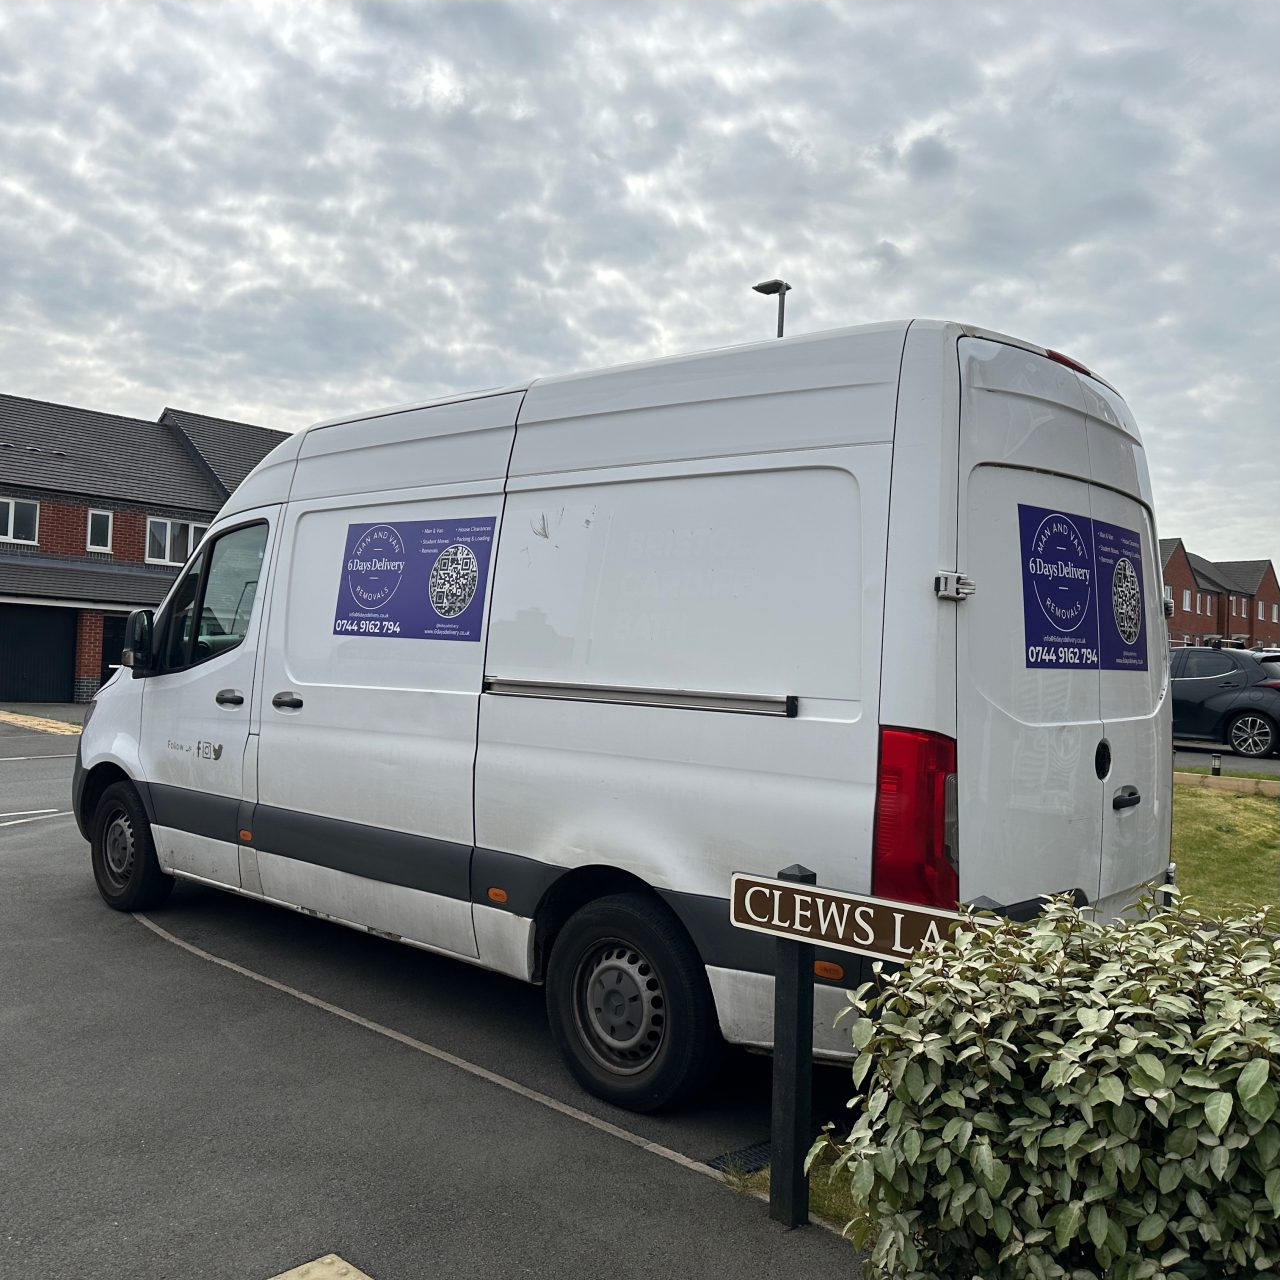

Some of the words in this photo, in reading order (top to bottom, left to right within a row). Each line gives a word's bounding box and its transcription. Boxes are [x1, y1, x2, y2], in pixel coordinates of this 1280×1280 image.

[356, 536, 371, 556] MAN
[373, 531, 388, 539] AND
[389, 535, 400, 553] VAN
[1037, 526, 1051, 554] MAN
[1052, 522, 1068, 535] AND
[1070, 530, 1083, 557] VAN
[347, 559, 352, 571] 6
[353, 560, 370, 574] Days
[371, 557, 405, 574] Delivery
[1030, 557, 1036, 574] 6
[1036, 558, 1058, 580] Days
[1058, 561, 1090, 584] Delivery
[356, 585, 389, 601] REMOVALS
[1046, 597, 1081, 620] REMOVALS
[335, 620, 358, 631] 0744
[360, 621, 380, 633] 9162
[382, 621, 400, 634] 794
[1028, 645, 1057, 663] 0744
[1058, 647, 1080, 664] 9162
[1081, 649, 1098, 664] 794
[744, 886, 874, 946] CLEWS
[892, 912, 964, 954] LA
